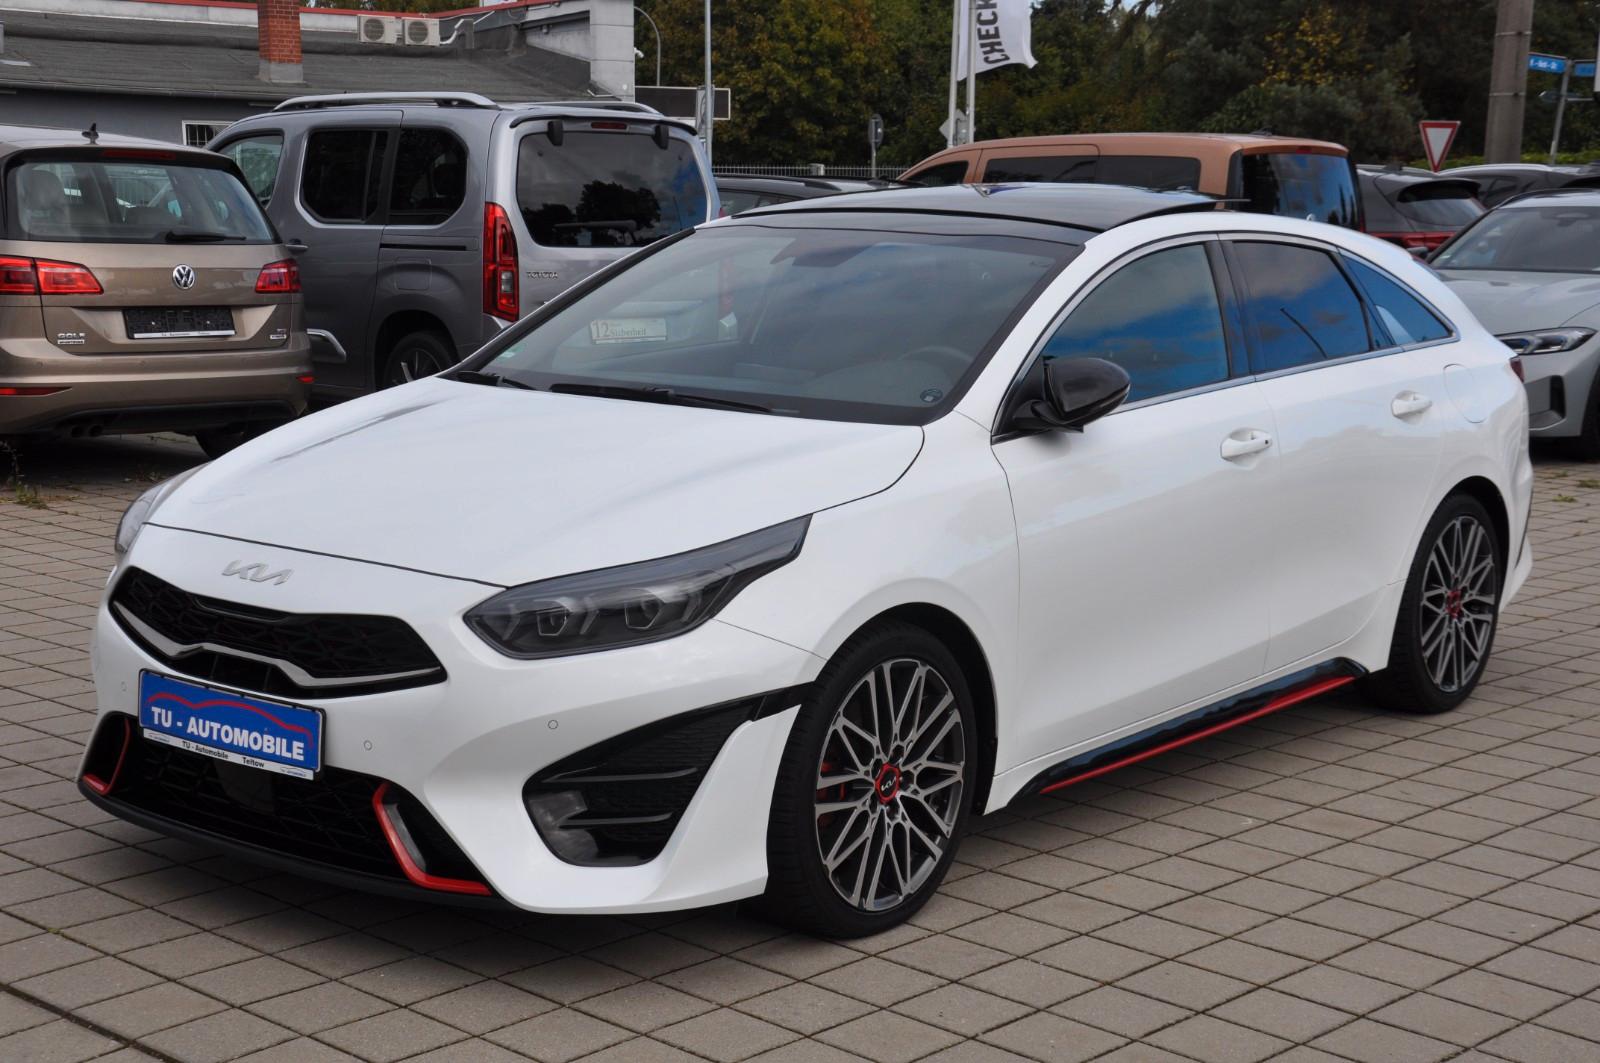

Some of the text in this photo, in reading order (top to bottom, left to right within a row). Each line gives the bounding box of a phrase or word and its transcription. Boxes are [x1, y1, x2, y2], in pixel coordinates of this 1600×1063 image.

[526, 271, 558, 279] TOYOTA
[151, 706, 173, 728] TU
[187, 716, 305, 761] AUTOMOBILE
[182, 740, 191, 749] TU
[195, 744, 229, 760] Automobile
